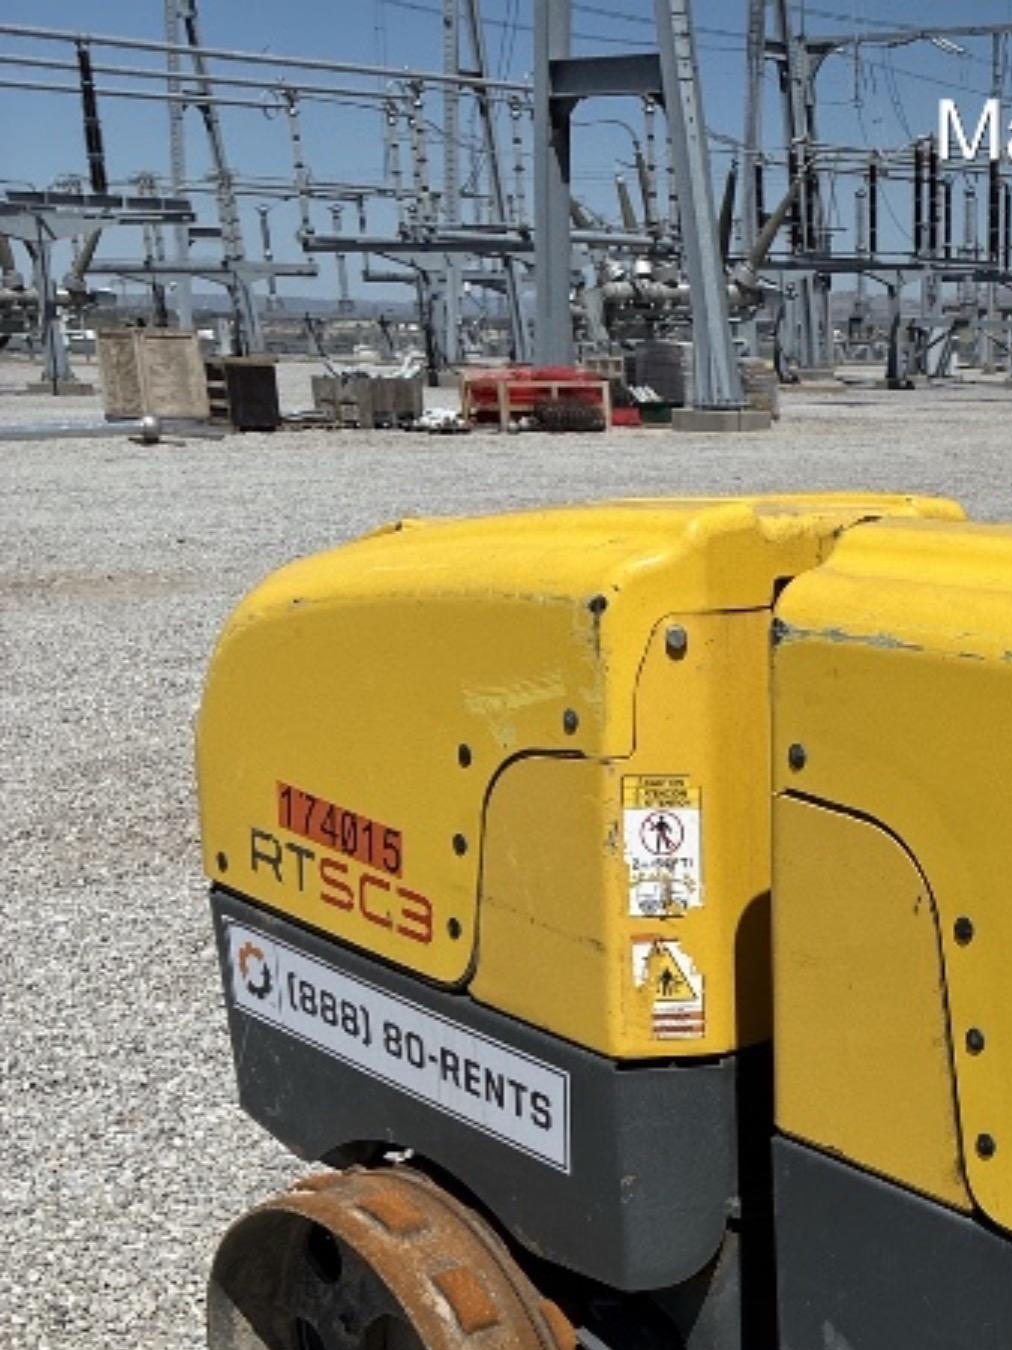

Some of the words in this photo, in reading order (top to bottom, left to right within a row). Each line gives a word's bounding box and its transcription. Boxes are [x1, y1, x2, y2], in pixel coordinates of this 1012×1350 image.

[250, 826, 434, 945] RTSC3
[280, 784, 402, 875] 174015
[286, 970, 373, 1047] (888)
[383, 1021, 553, 1130] 80-RENTS
